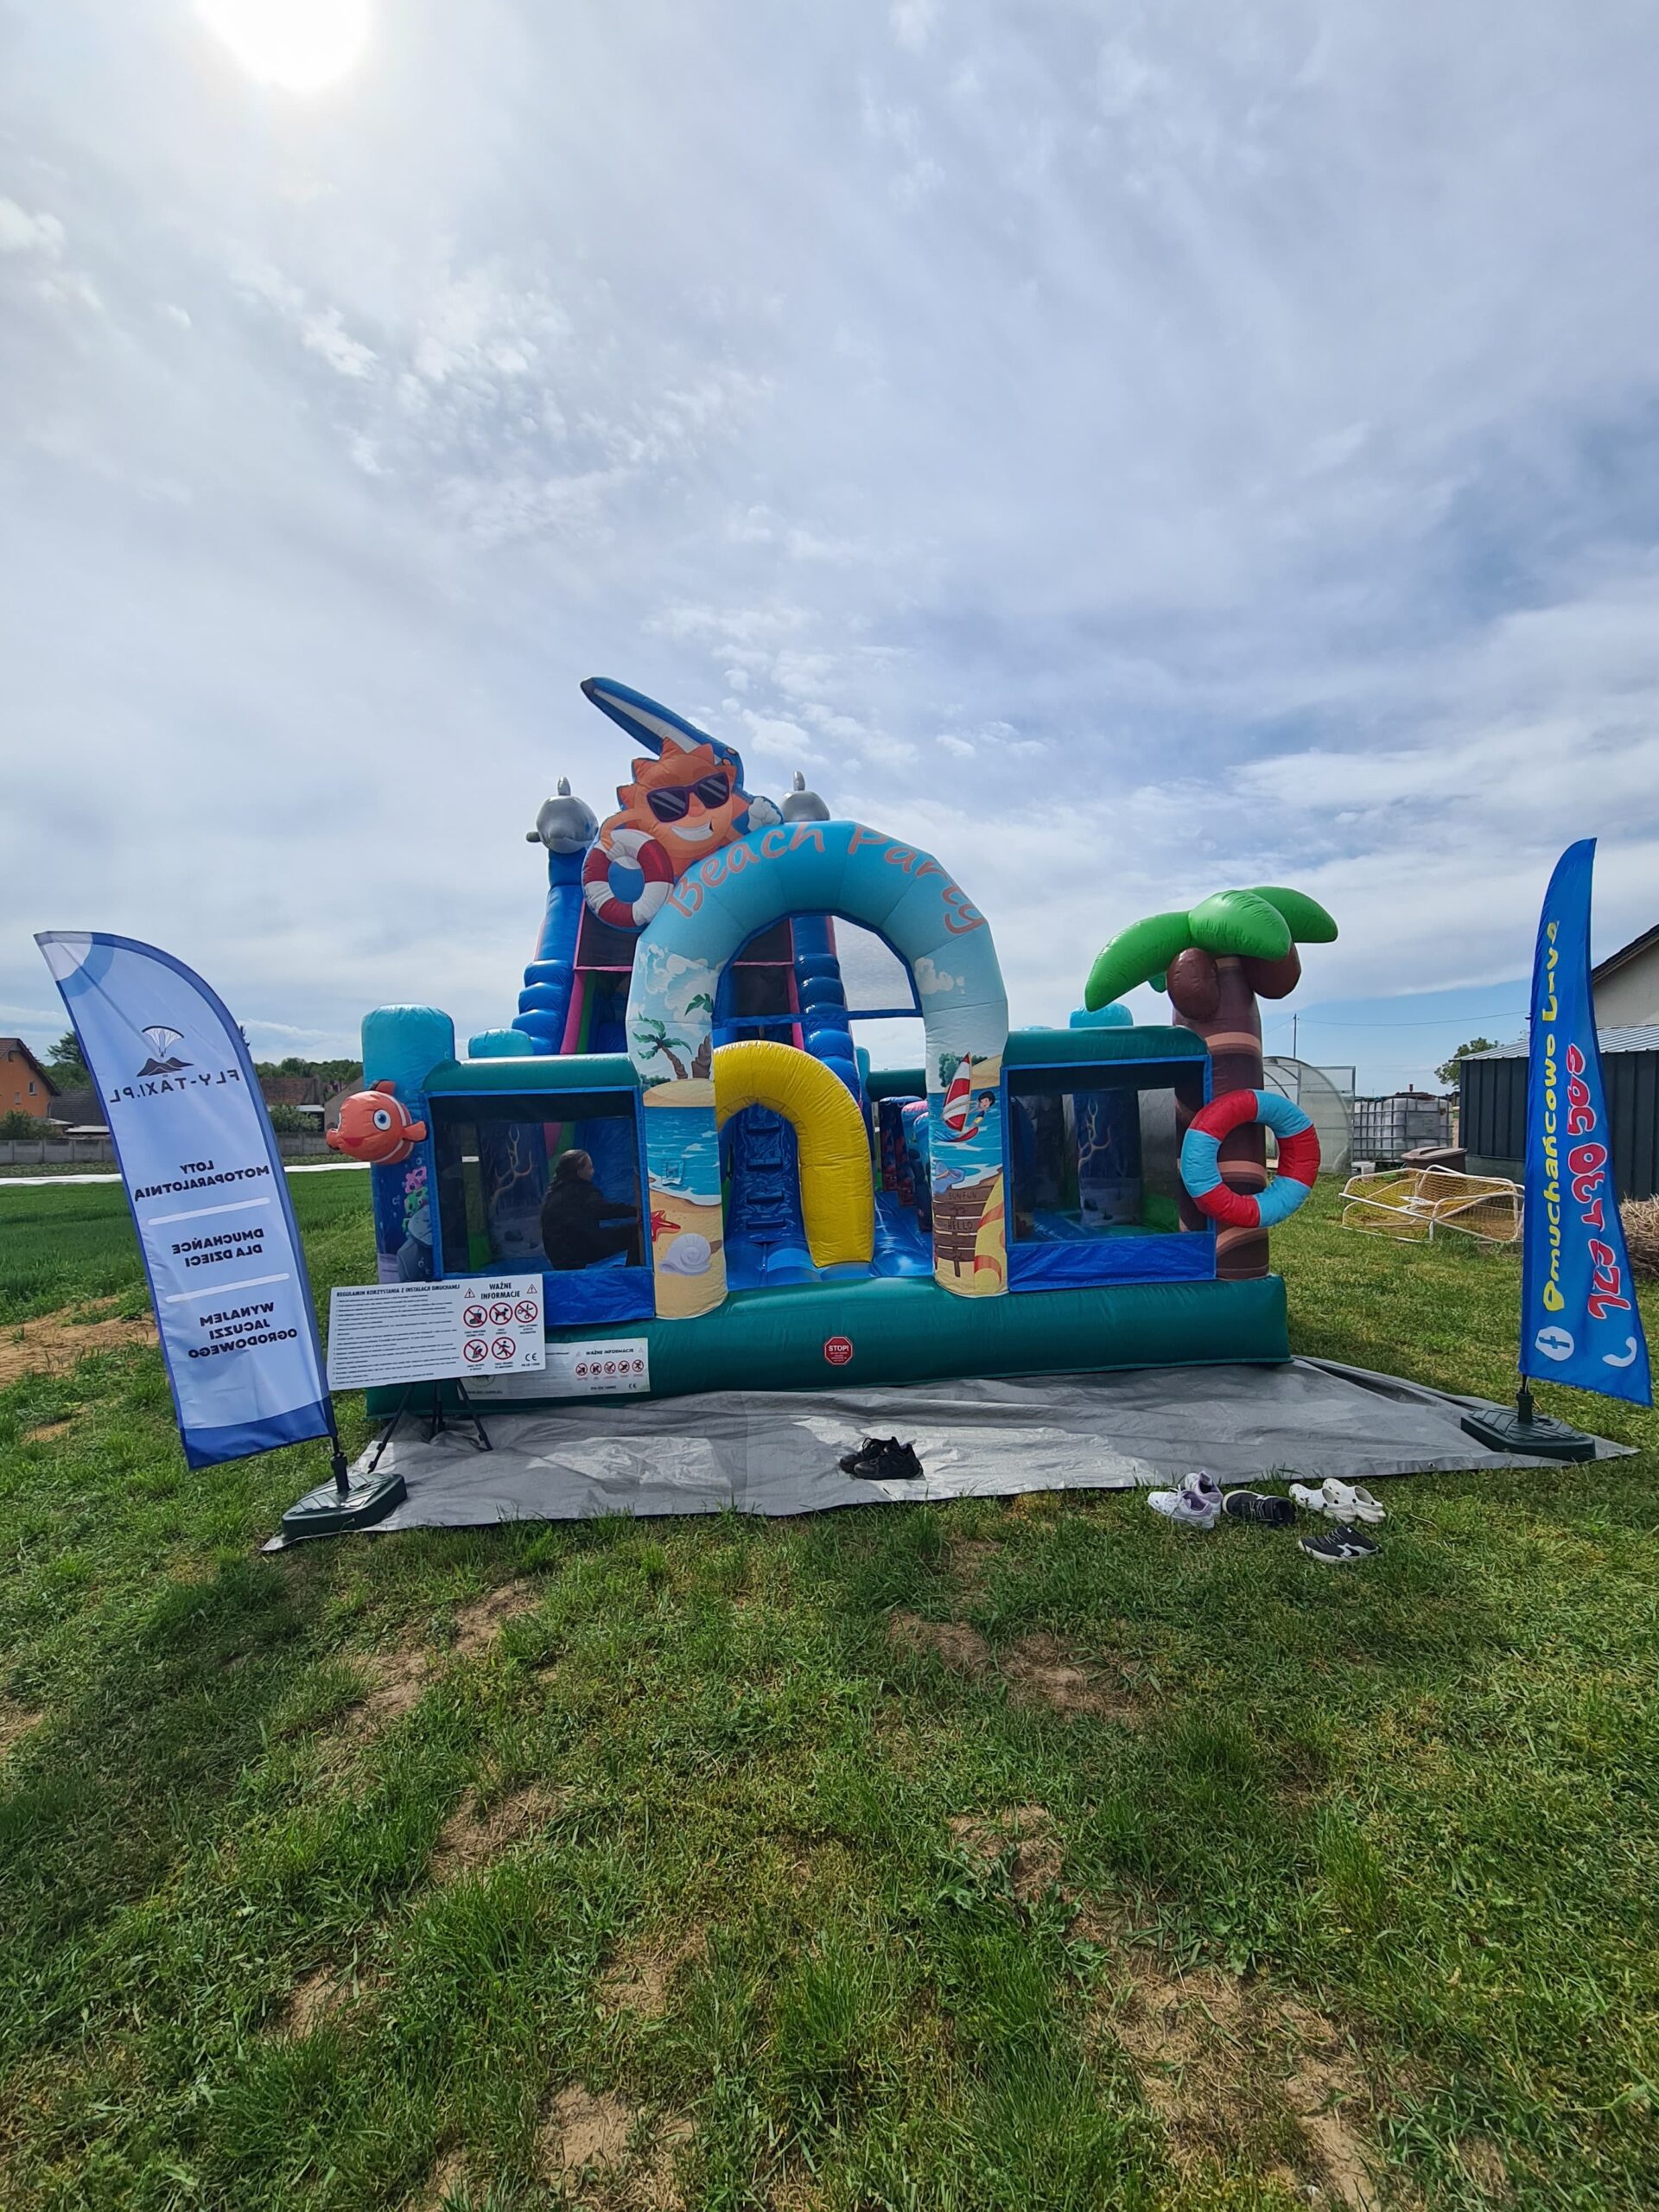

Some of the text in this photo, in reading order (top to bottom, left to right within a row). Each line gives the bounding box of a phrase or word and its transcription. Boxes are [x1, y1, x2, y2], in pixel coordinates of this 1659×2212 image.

[666, 823, 825, 918] Beach
[948, 1221, 973, 1230] HELLO
[489, 1281, 512, 1290] WAŻNE
[480, 1291, 520, 1300] INFORMACJE
